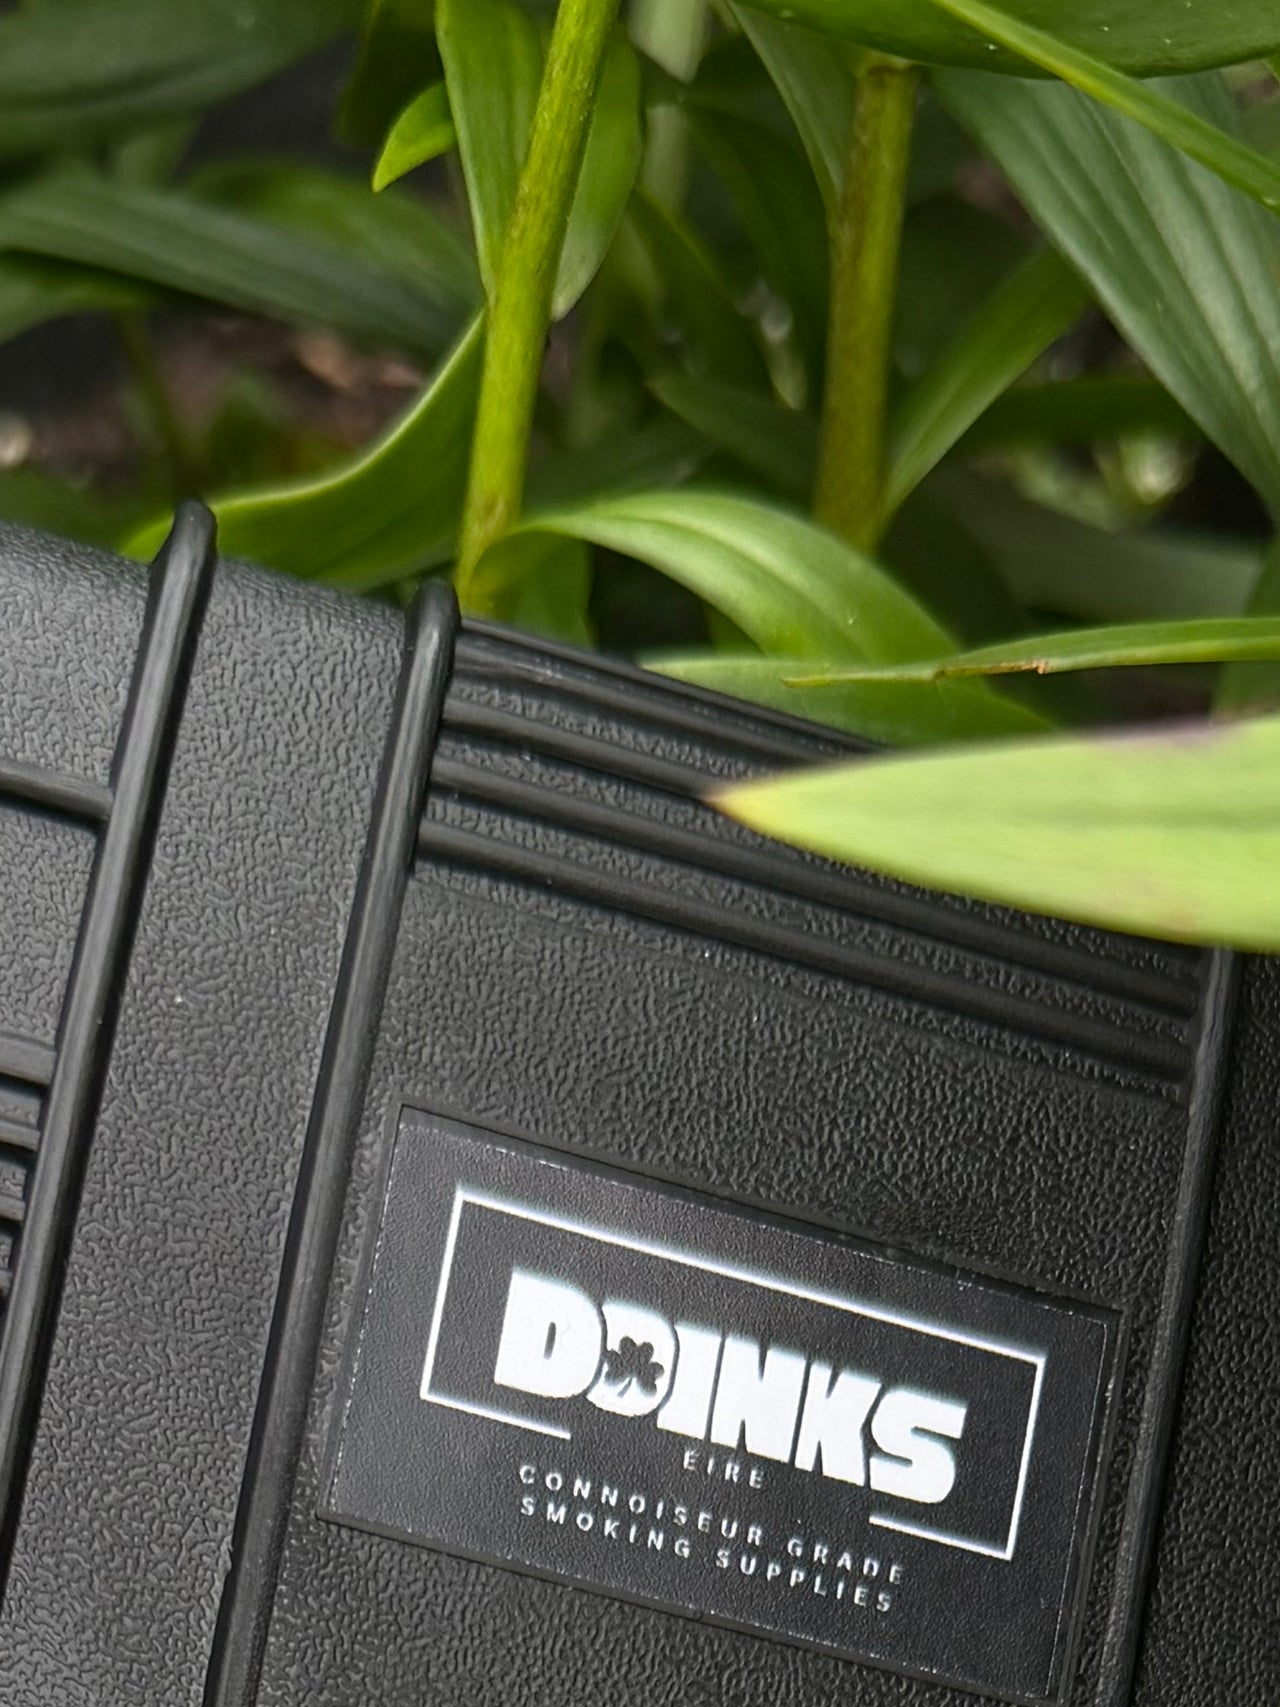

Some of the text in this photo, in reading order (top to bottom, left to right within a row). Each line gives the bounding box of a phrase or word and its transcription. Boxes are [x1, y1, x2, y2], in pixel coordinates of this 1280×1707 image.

[493, 1268, 970, 1506] DOINKS
[519, 1464, 906, 1585] CONNOISEUR GRADE
[520, 1496, 892, 1613] SMOKING SUPPLIES
